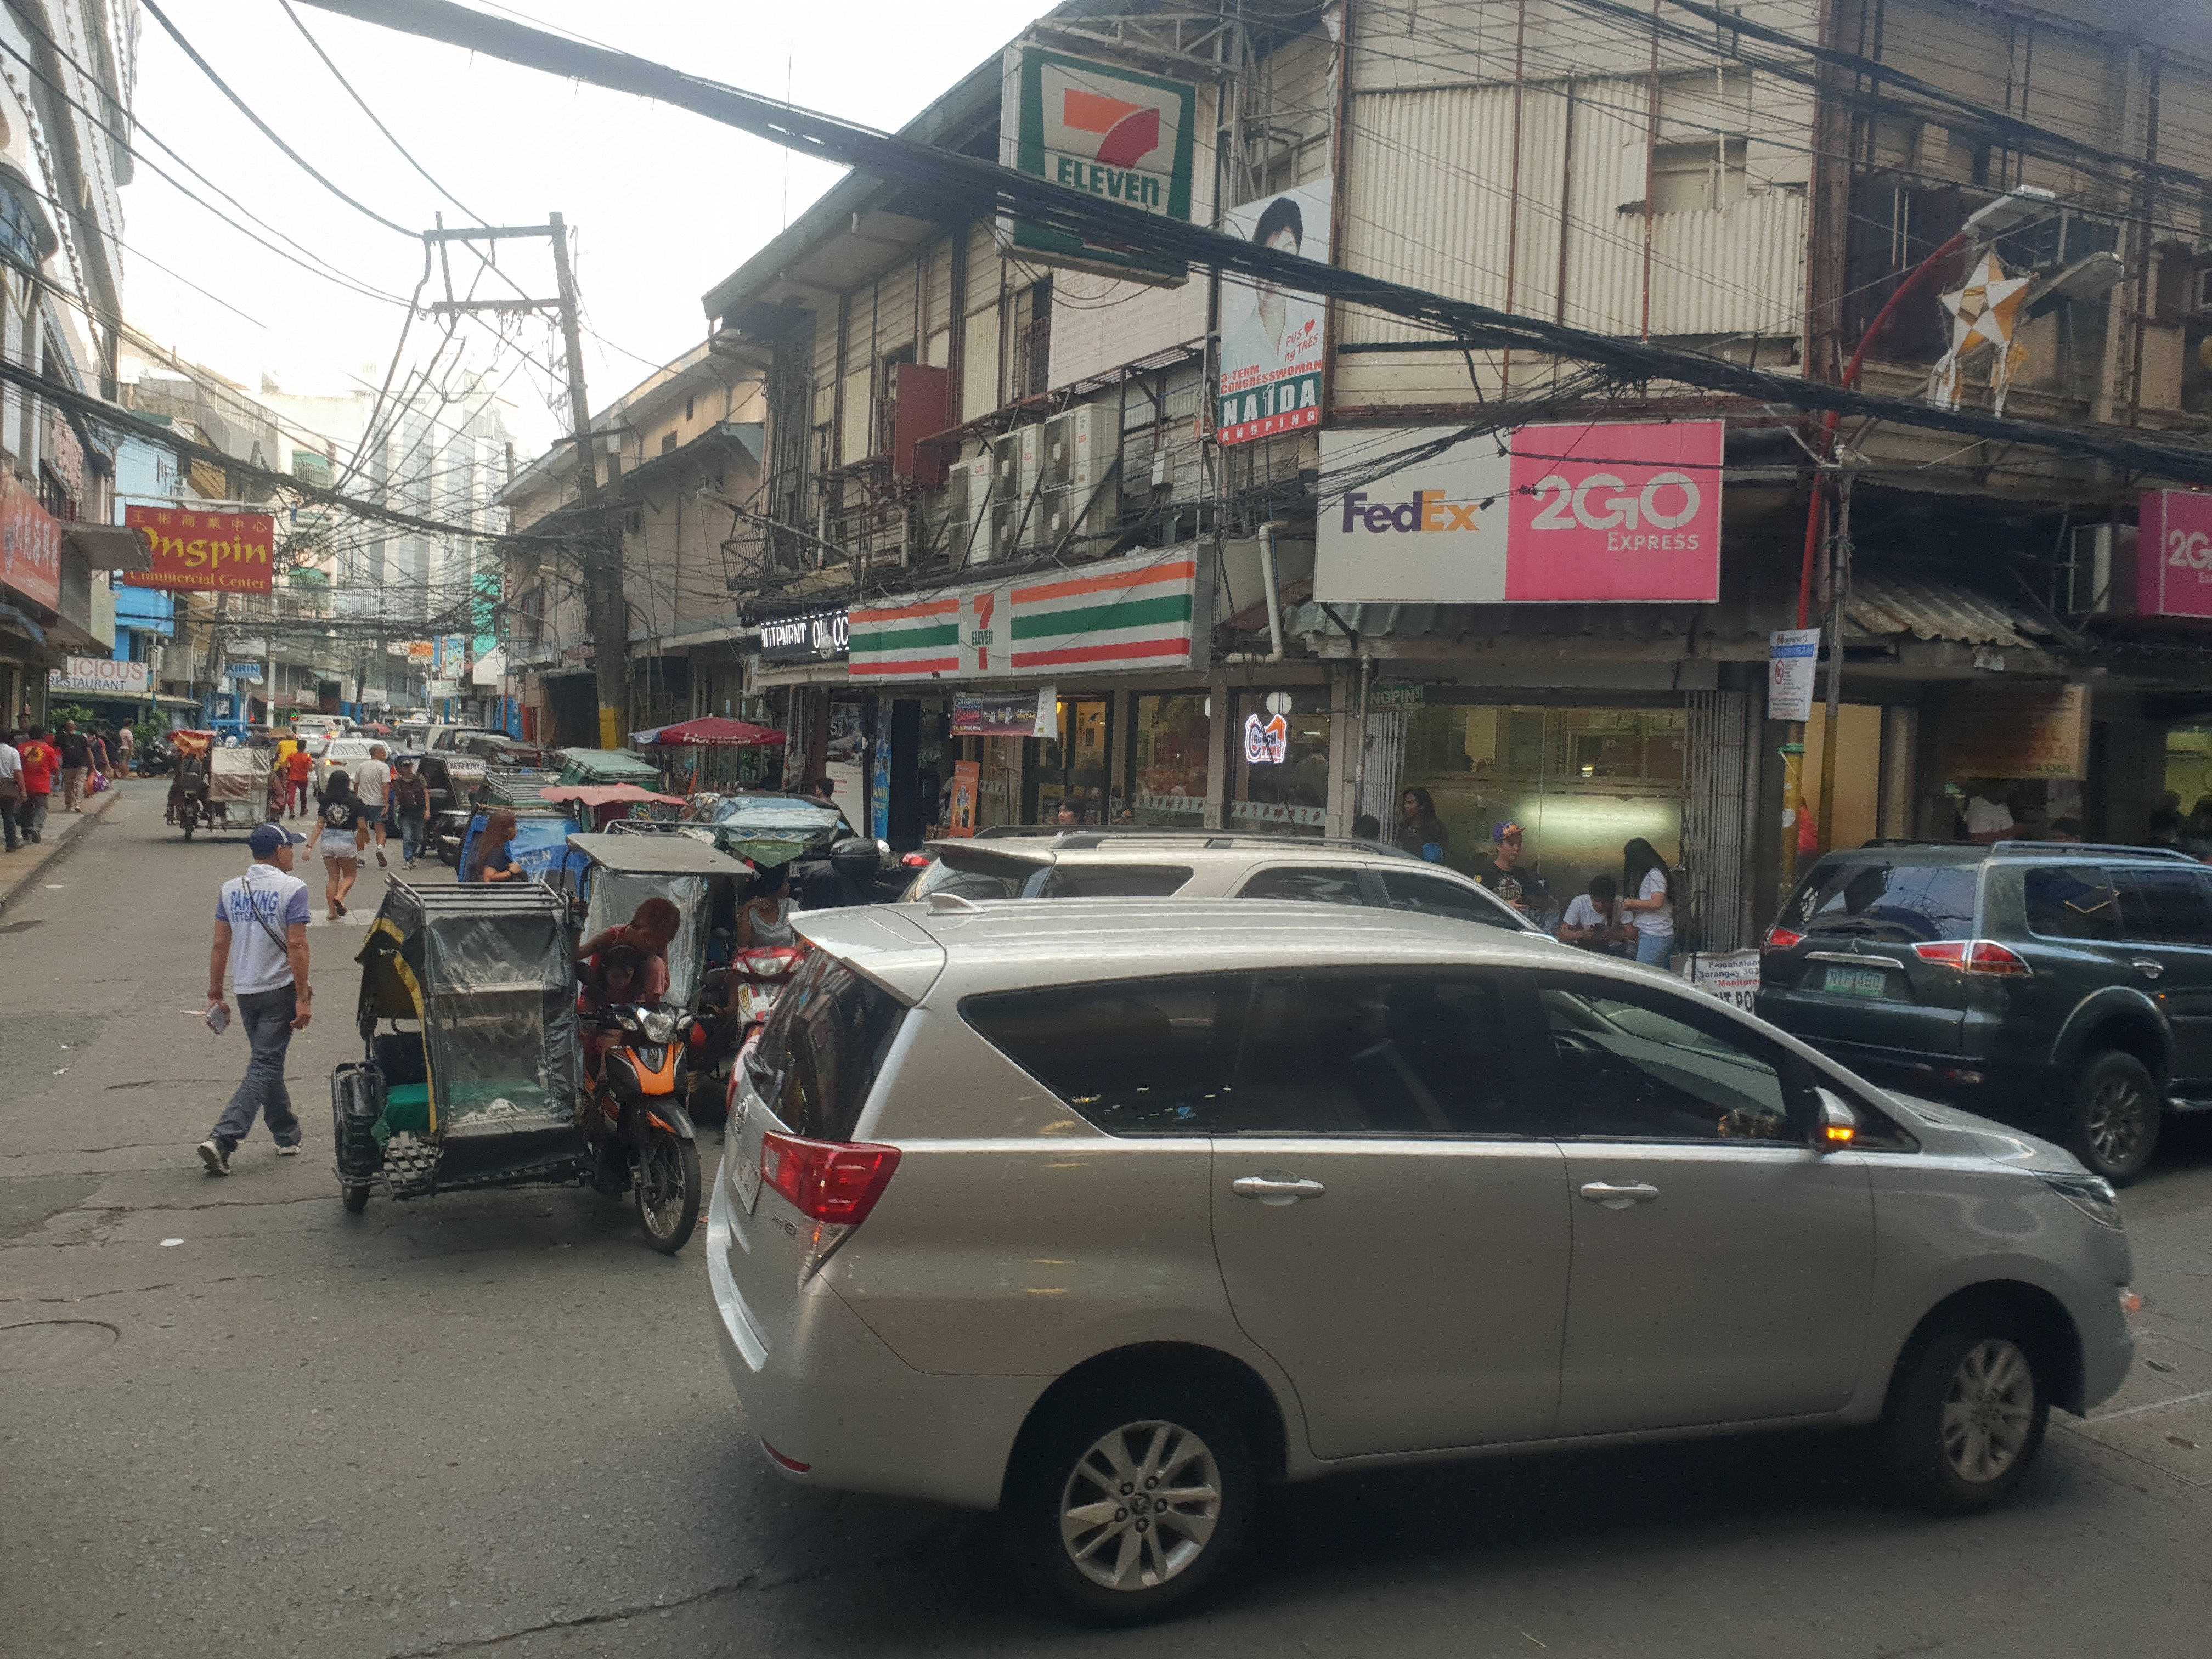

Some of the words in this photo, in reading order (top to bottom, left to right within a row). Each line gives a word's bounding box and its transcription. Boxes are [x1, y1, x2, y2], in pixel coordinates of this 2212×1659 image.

[1284, 349, 1296, 363] ng
[1297, 332, 1318, 356] TRES
[1285, 328, 1303, 348] PUS
[1221, 364, 1260, 383] 3-TERM
[1221, 359, 1322, 395] CONGRESSWOMAN
[1222, 410, 1316, 442] ANGPING
[1342, 490, 1480, 533] FedEx
[1531, 471, 1701, 531] 2GO
[219, 574, 266, 589] Center
[1370, 689, 1415, 706] NGPIN
[1743, 967, 1760, 976] 303
